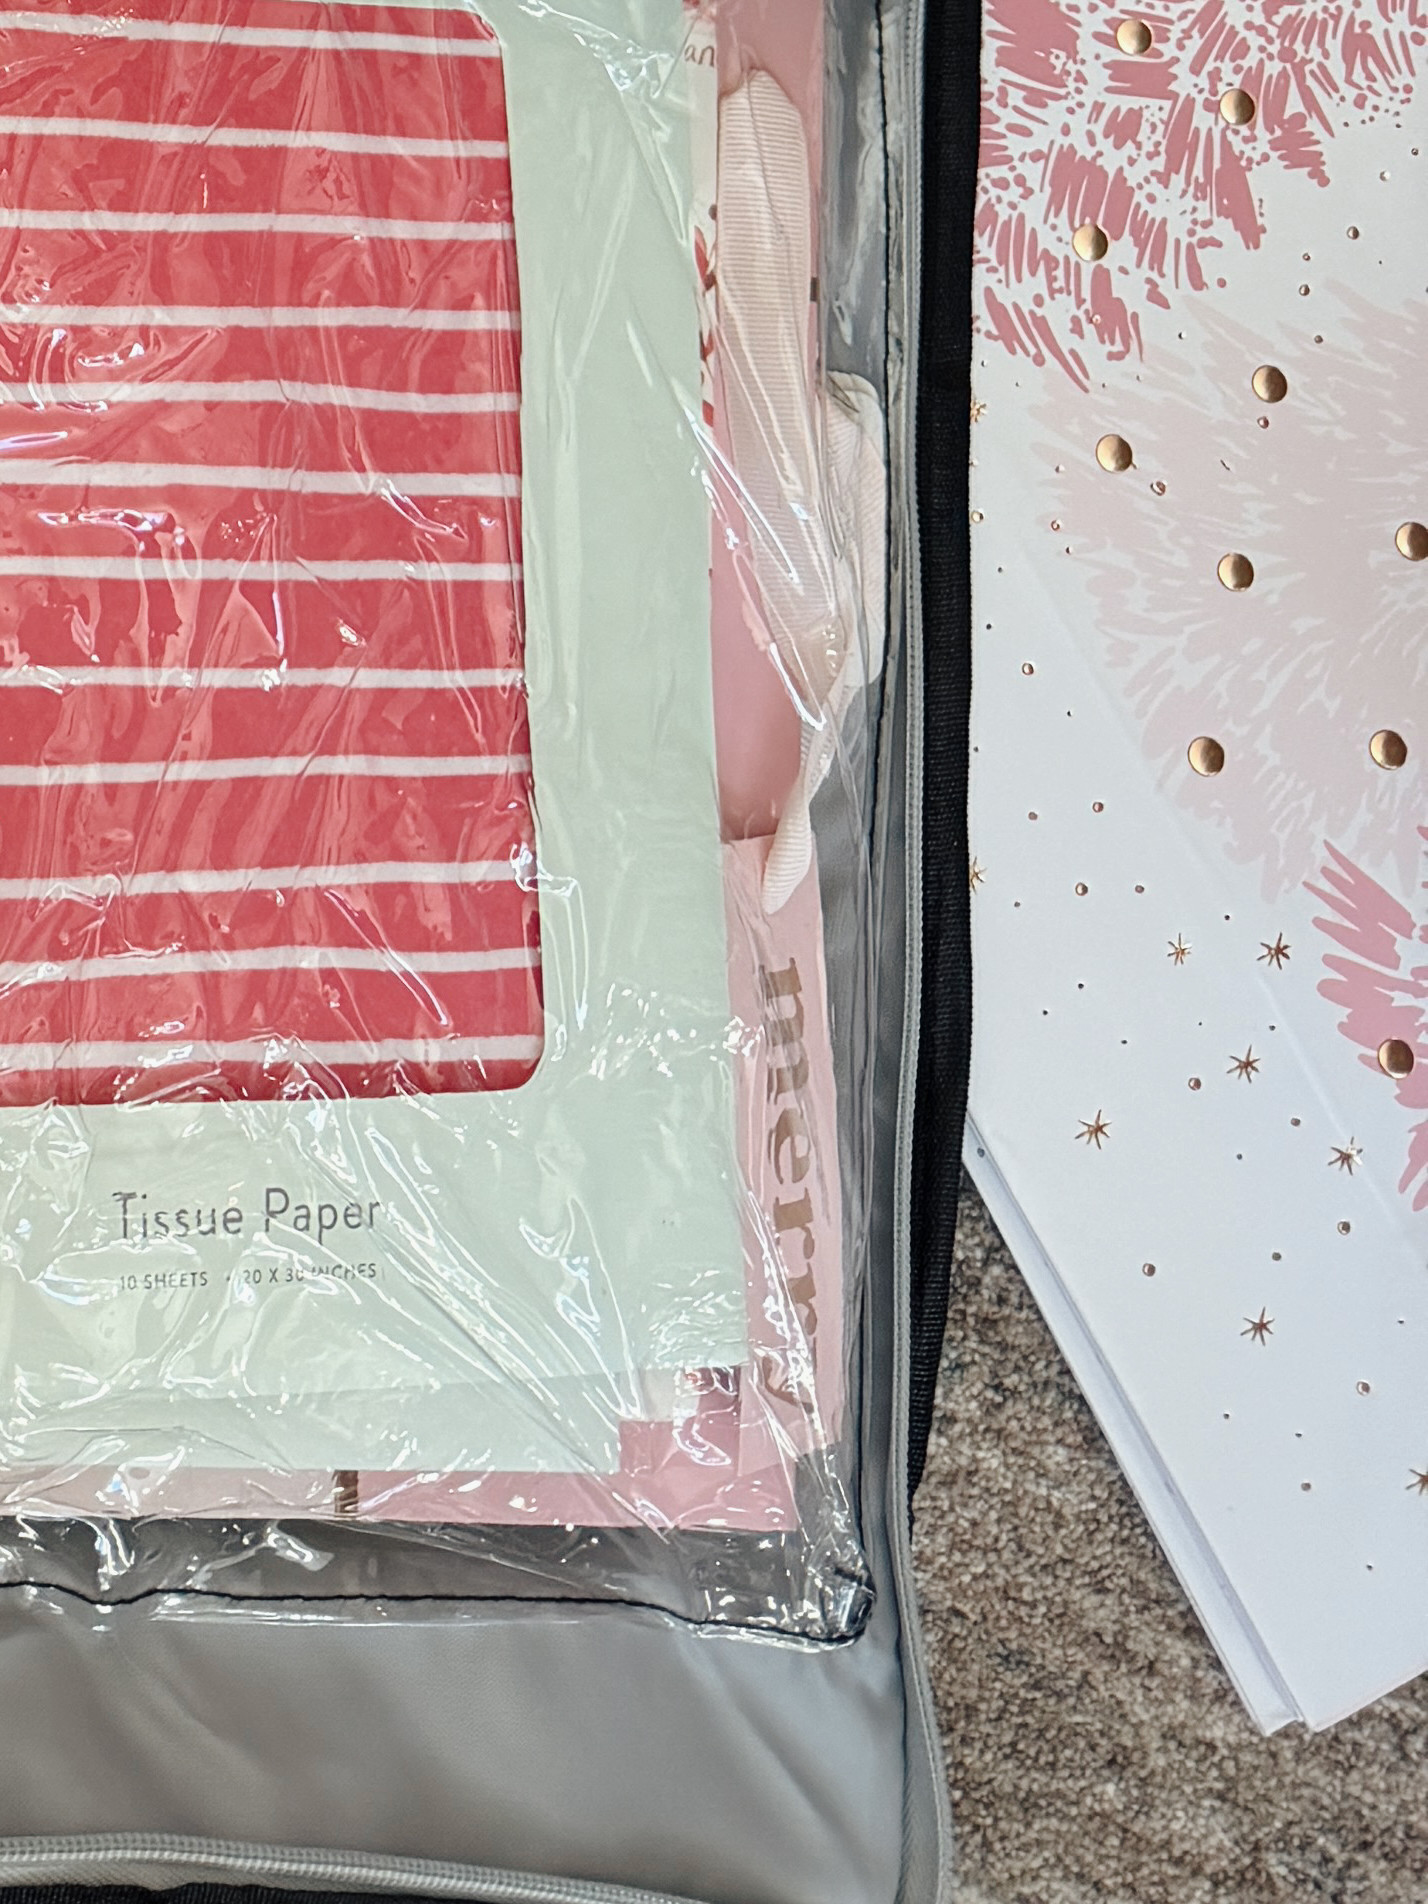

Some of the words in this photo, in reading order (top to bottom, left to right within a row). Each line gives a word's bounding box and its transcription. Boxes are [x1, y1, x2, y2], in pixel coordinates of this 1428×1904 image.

[111, 1190, 244, 1240] Tissue
[264, 1187, 381, 1246] Paper
[120, 1274, 137, 1290] 10
[143, 1271, 209, 1289] SHEETS
